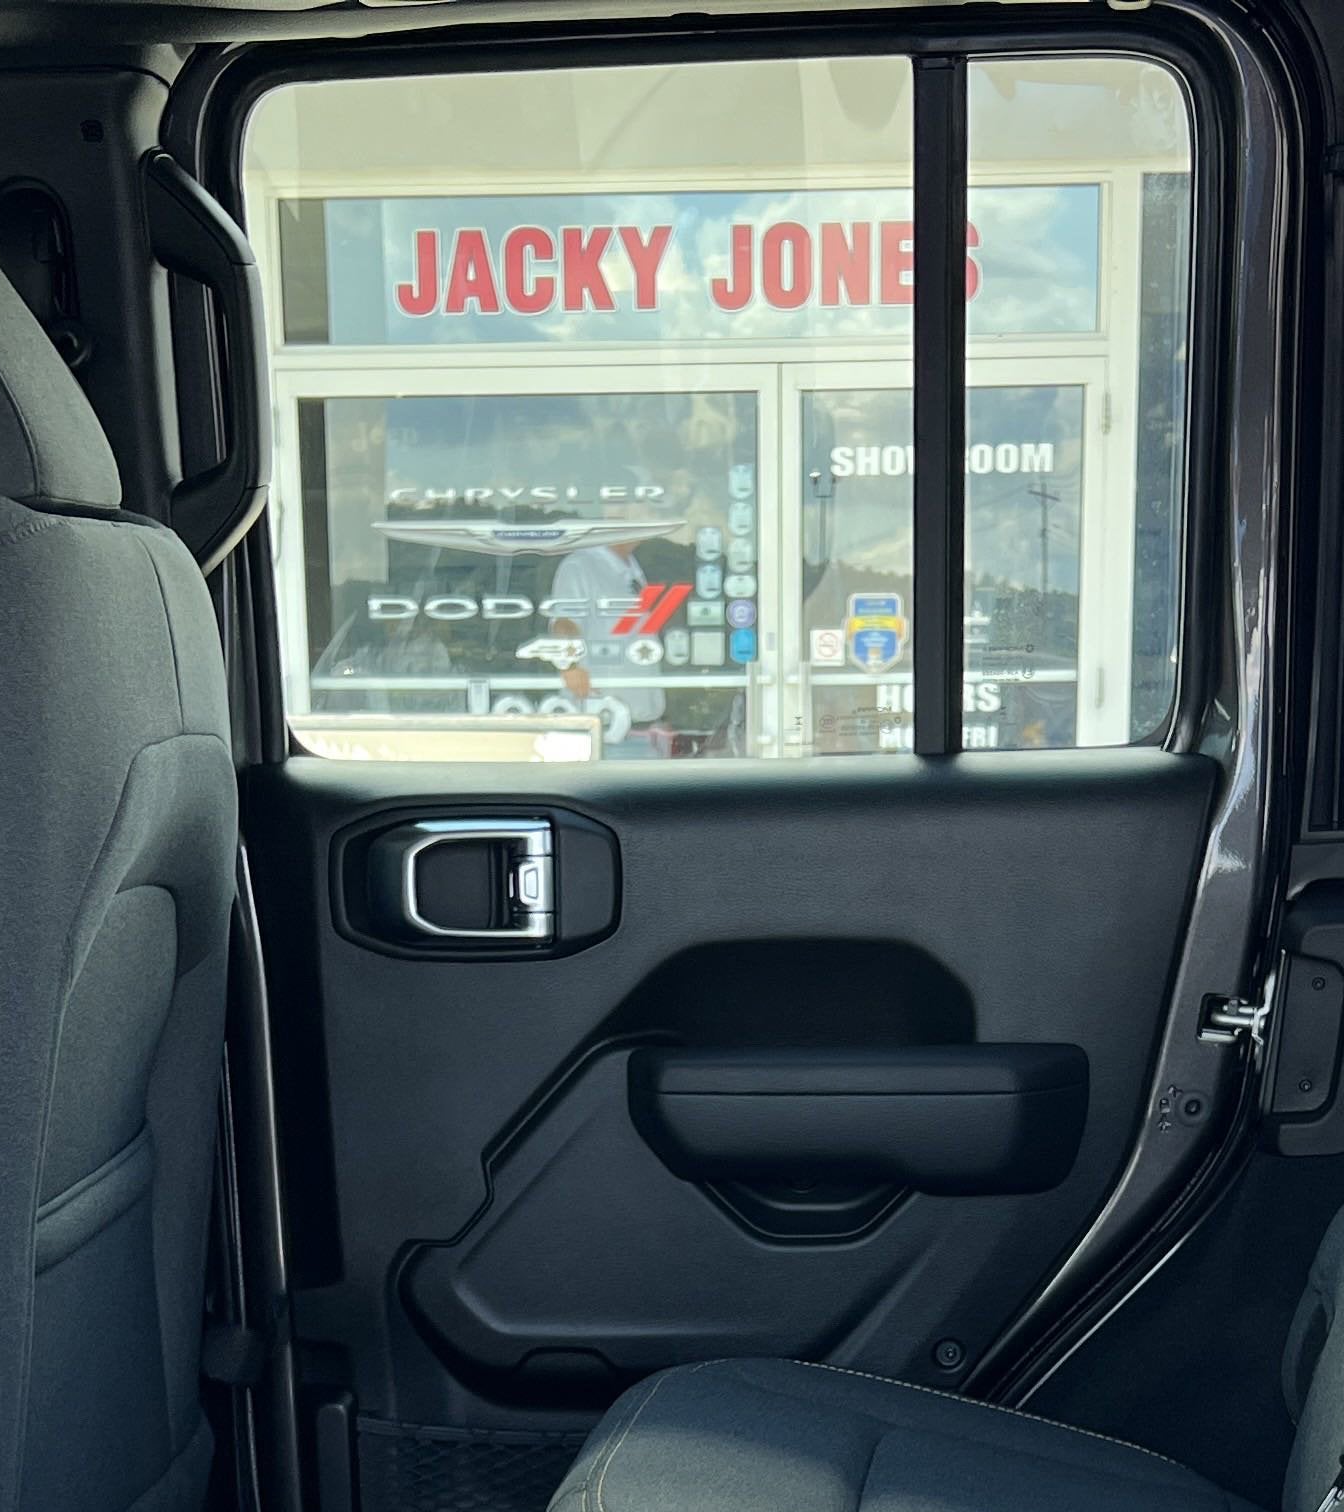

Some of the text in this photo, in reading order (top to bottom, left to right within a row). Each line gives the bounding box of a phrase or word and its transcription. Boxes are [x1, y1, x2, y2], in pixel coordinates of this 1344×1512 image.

[396, 220, 983, 316] JACKY JONE
[830, 443, 1054, 477] SHOOOM
[389, 485, 665, 503] CHRYSLER
[367, 597, 643, 620] DODGE
